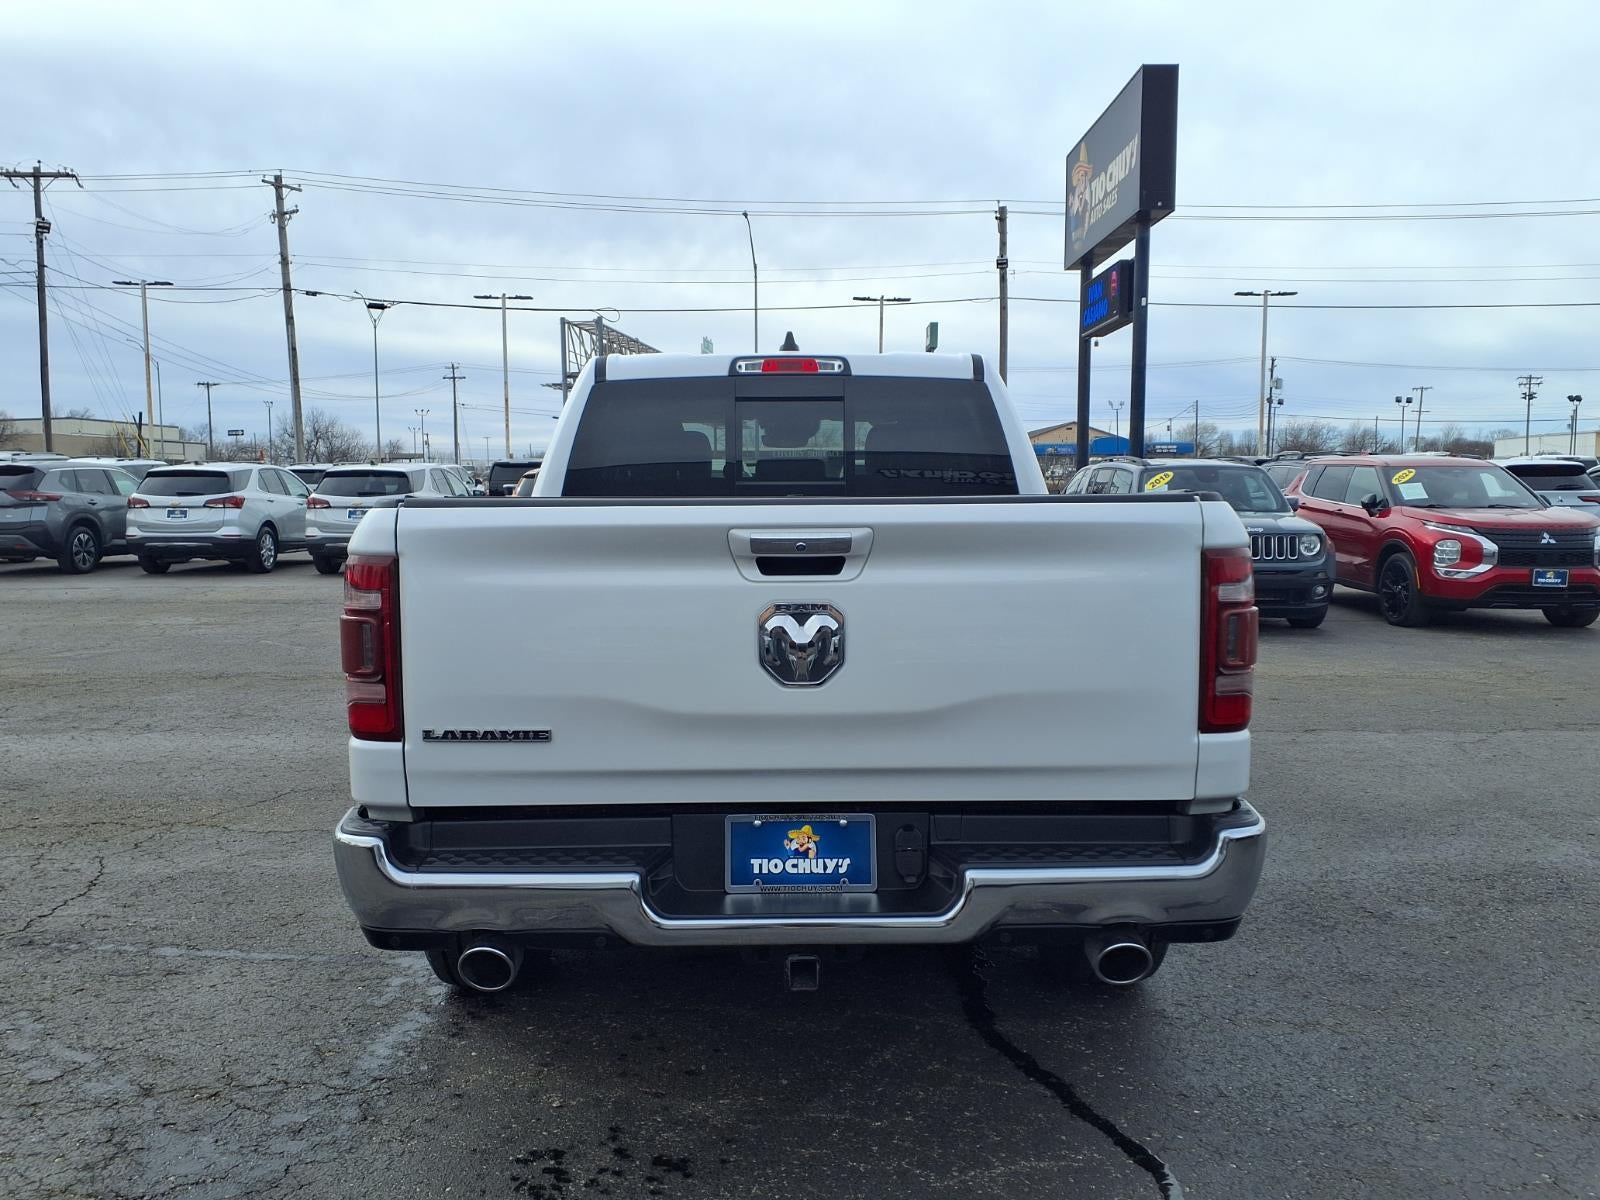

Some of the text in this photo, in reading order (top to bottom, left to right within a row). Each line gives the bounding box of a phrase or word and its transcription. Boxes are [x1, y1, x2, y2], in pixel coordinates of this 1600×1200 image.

[1091, 171, 1106, 208] TIO
[1103, 187, 1118, 216] SALES
[1149, 472, 1171, 489] 2018
[1394, 469, 1414, 483] 2024
[775, 603, 829, 612] RAM
[422, 729, 552, 742] LARAMIE
[751, 858, 851, 874] TIO CHUY'S
